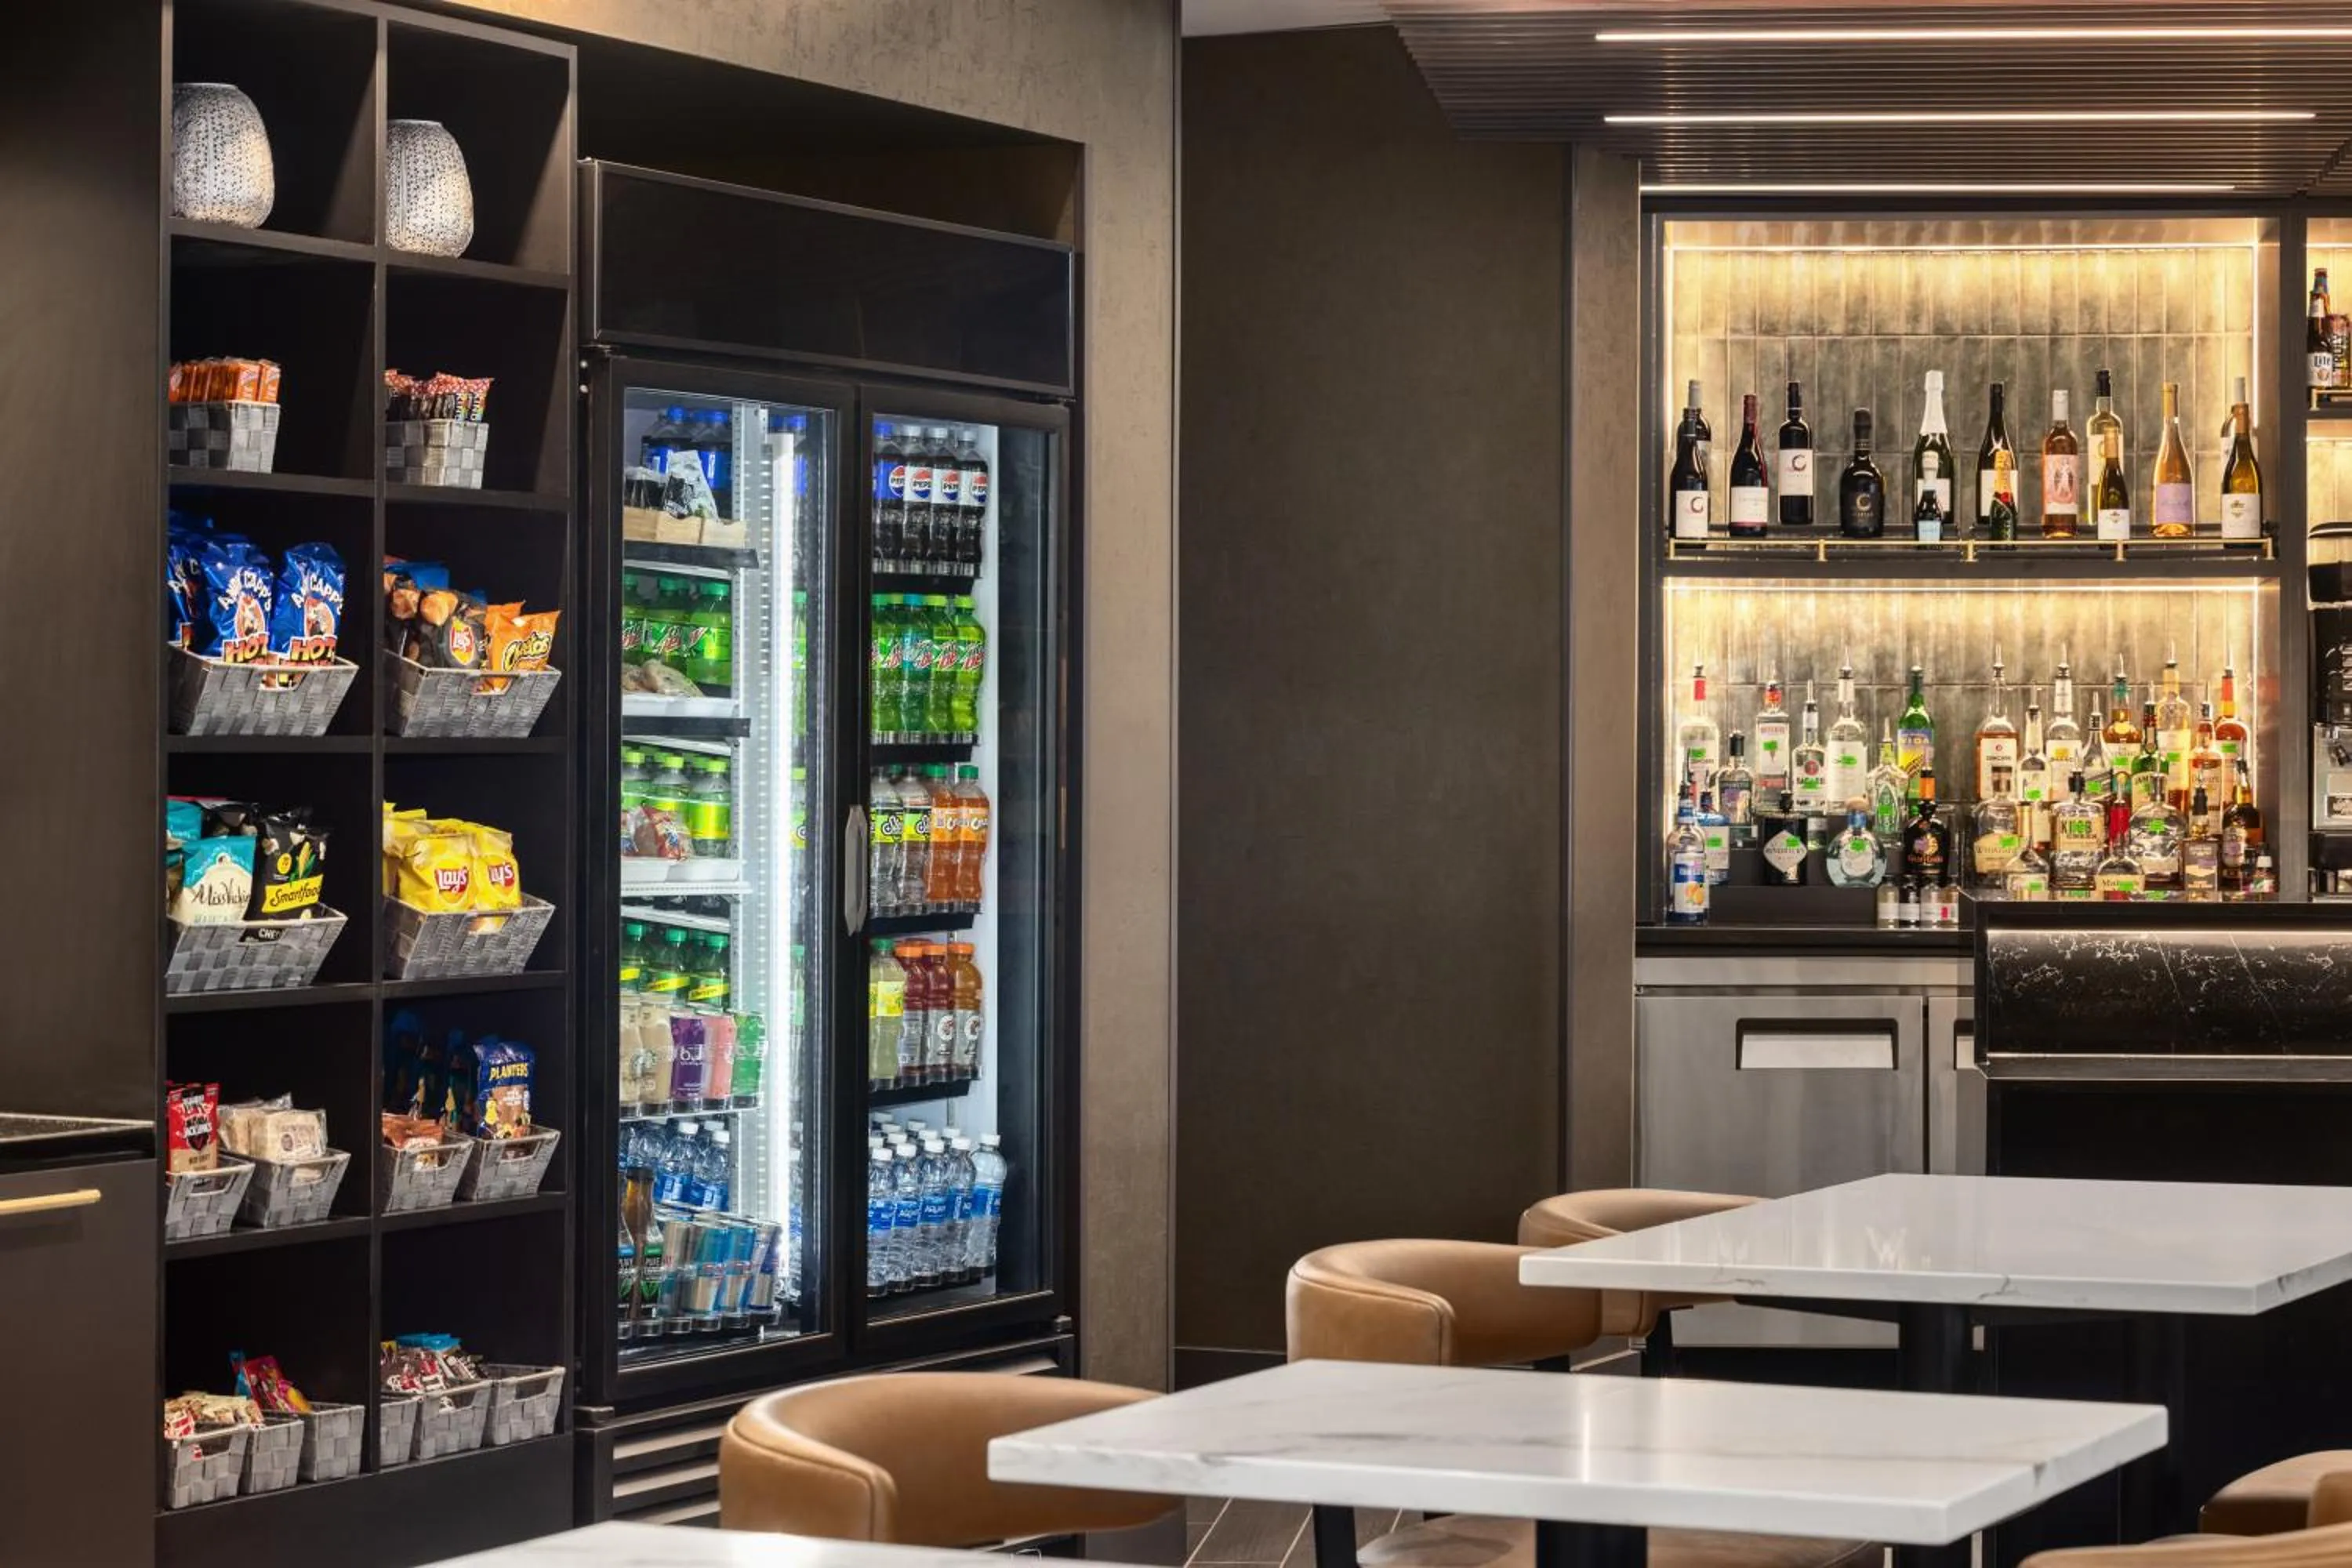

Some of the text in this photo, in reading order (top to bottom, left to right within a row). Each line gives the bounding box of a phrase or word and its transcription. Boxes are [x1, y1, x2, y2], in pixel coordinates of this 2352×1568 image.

[223, 633, 268, 662] HOT
[291, 636, 336, 661] HOT
[437, 867, 469, 893] Lay's
[489, 1063, 528, 1080] PLANTERS
